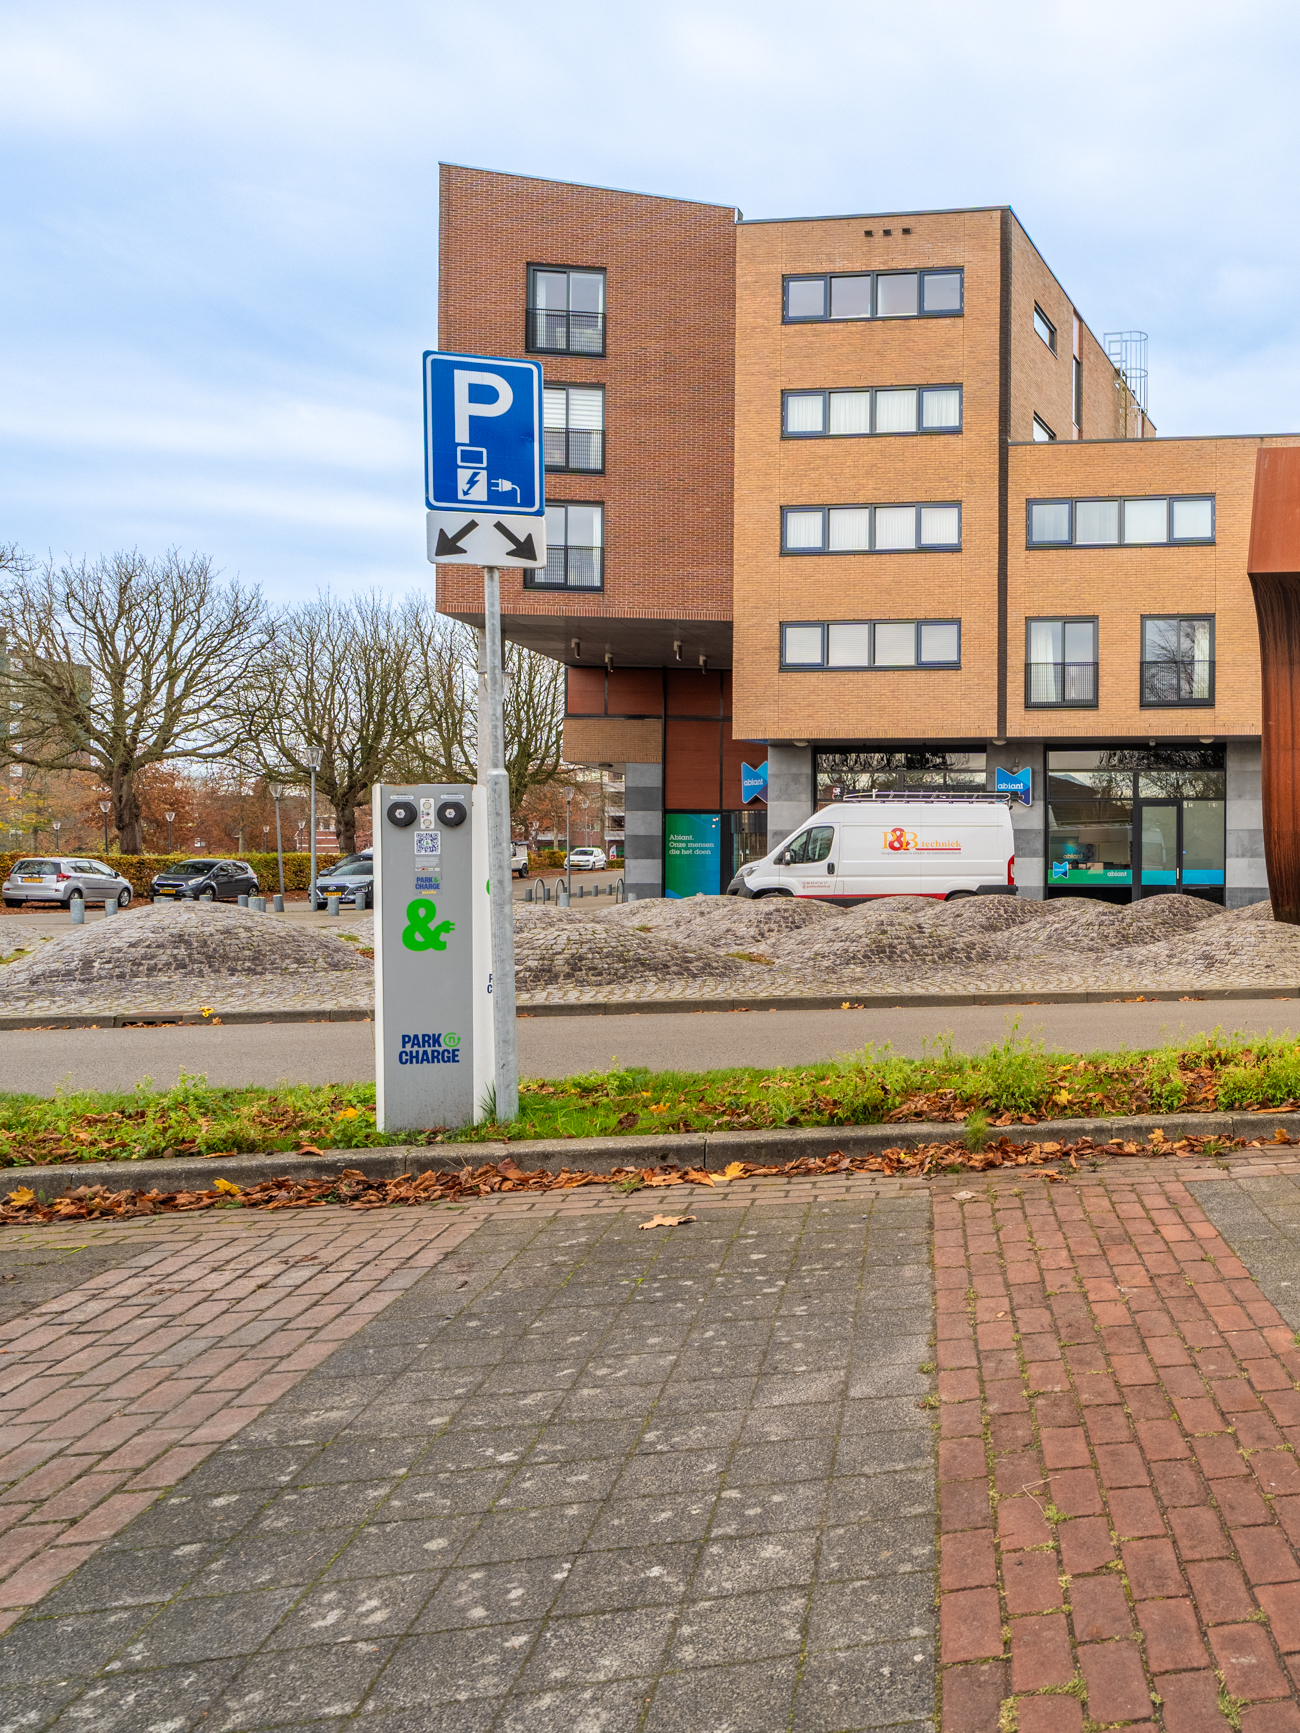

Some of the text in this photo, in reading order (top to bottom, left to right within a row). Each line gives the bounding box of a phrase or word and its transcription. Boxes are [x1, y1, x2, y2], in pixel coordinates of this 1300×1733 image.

[454, 369, 514, 444] P
[743, 778, 764, 787] abiant
[997, 782, 1024, 790] abiant
[401, 1033, 442, 1049] PARK
[398, 1048, 460, 1065] CHARGE
